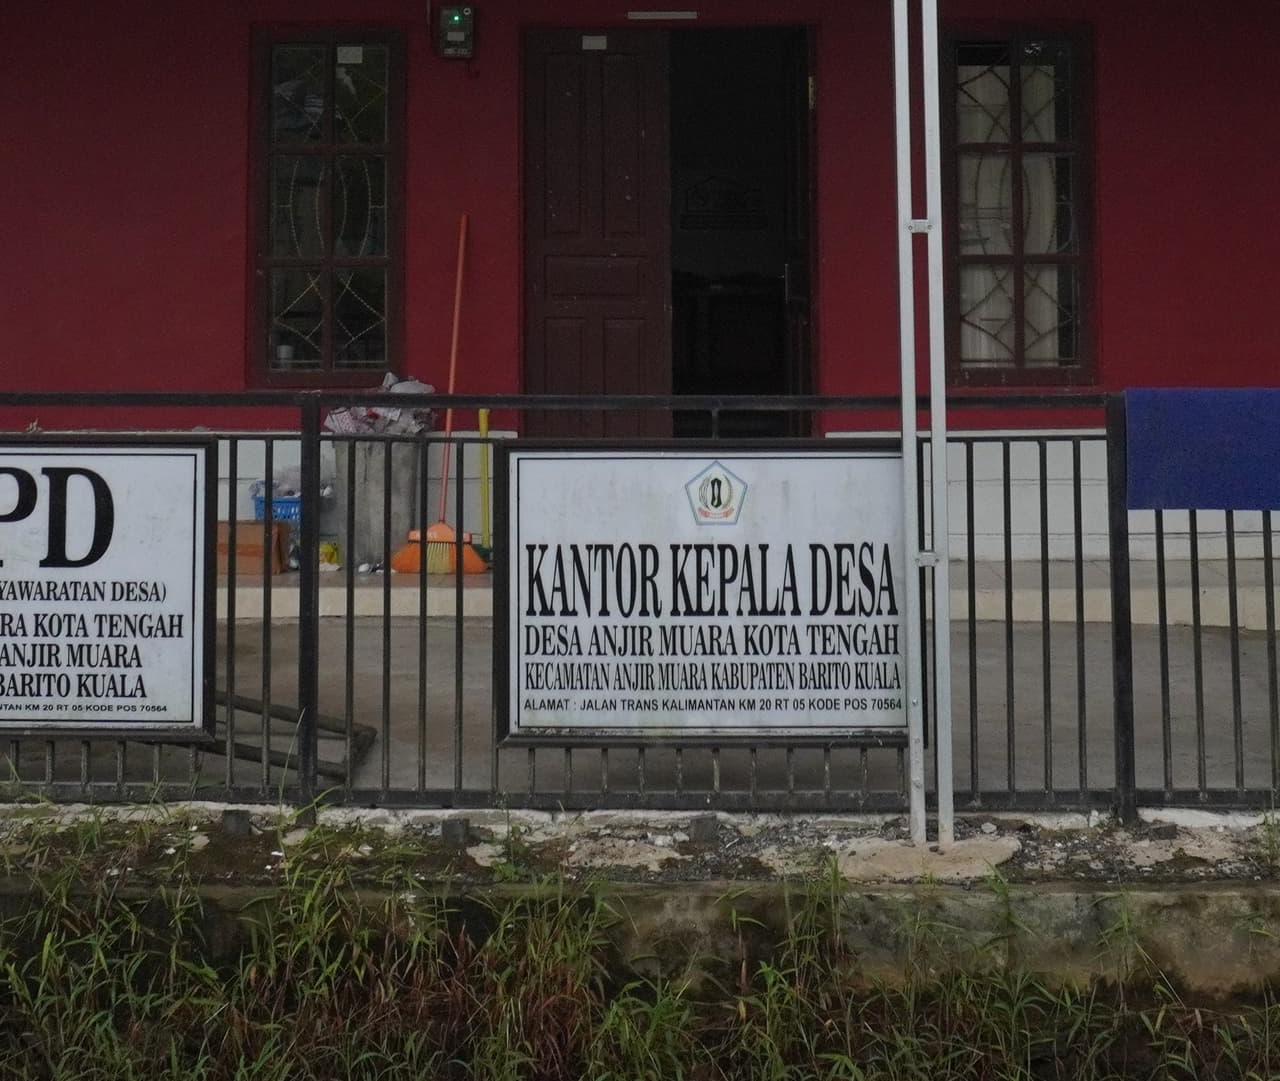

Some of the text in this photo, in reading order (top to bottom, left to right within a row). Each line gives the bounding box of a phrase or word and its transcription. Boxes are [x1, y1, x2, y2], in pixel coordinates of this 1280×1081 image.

[111, 582, 166, 602] DESA)
[526, 542, 898, 618] KANTOR KEPALA DESA
[33, 613, 89, 637] KOTA
[94, 614, 184, 638] TENGAH
[525, 624, 899, 656] DESA ANJIR MUARA KOTA TENGAH
[66, 644, 142, 668] MUARA
[77, 674, 147, 698] KUALA
[525, 662, 901, 691] KECAMATAN ANJIR MUARA KABUPATEN BARITO KUALA
[524, 699, 569, 710] ALAMAT
[580, 699, 616, 710] JALAN
[621, 699, 658, 711] TRANS
[662, 699, 735, 711] KALIMANTAN
[739, 699, 755, 711] KM
[760, 699, 771, 710] 20
[775, 699, 789, 710] RT
[793, 699, 805, 710] 05
[809, 698, 840, 710] KODE
[844, 698, 867, 710] POS
[871, 698, 902, 710] 70564
